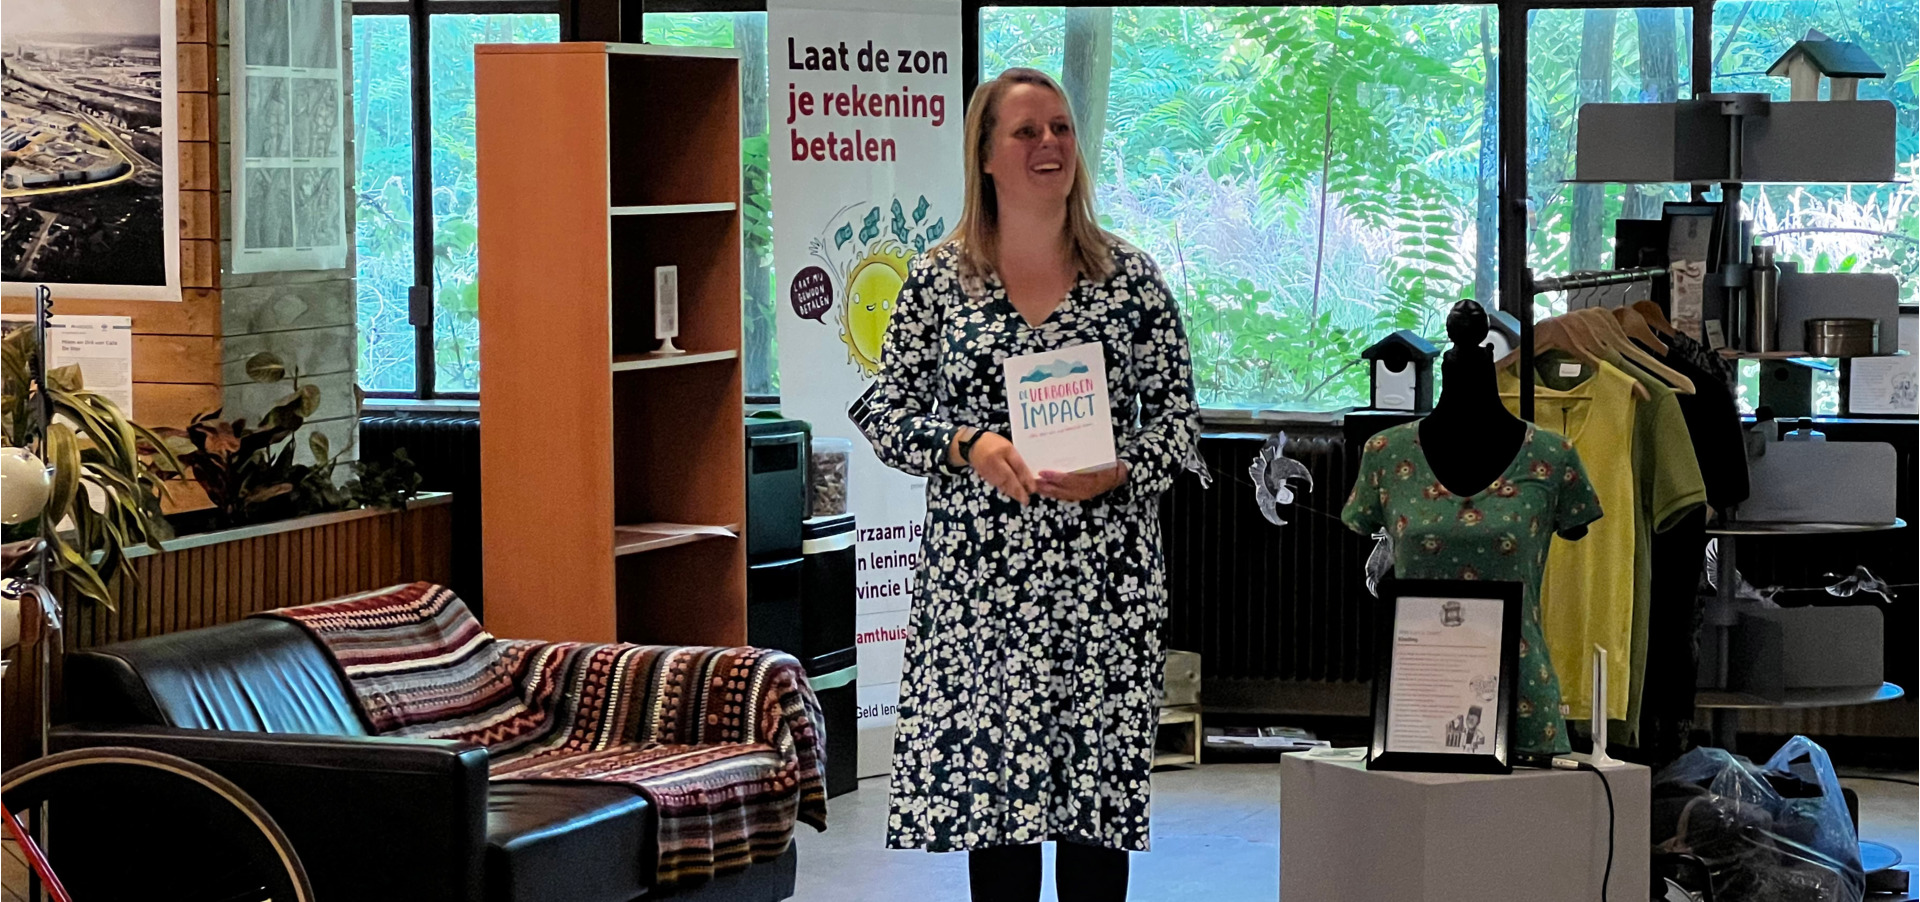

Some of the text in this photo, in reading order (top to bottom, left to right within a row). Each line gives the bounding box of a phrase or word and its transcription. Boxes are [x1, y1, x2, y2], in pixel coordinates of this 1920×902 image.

[788, 37, 947, 74] Laat de zon
[787, 83, 945, 126] je rekening
[791, 128, 896, 161] betalen
[793, 276, 810, 292] LAAT
[798, 284, 825, 303] GEWOON
[799, 295, 830, 315] BETALEN
[1029, 378, 1094, 402] VERBORGEN
[1021, 394, 1095, 429] IMPACT
[909, 520, 923, 542] je
[871, 550, 917, 571] lening
[857, 704, 878, 719] Geld
